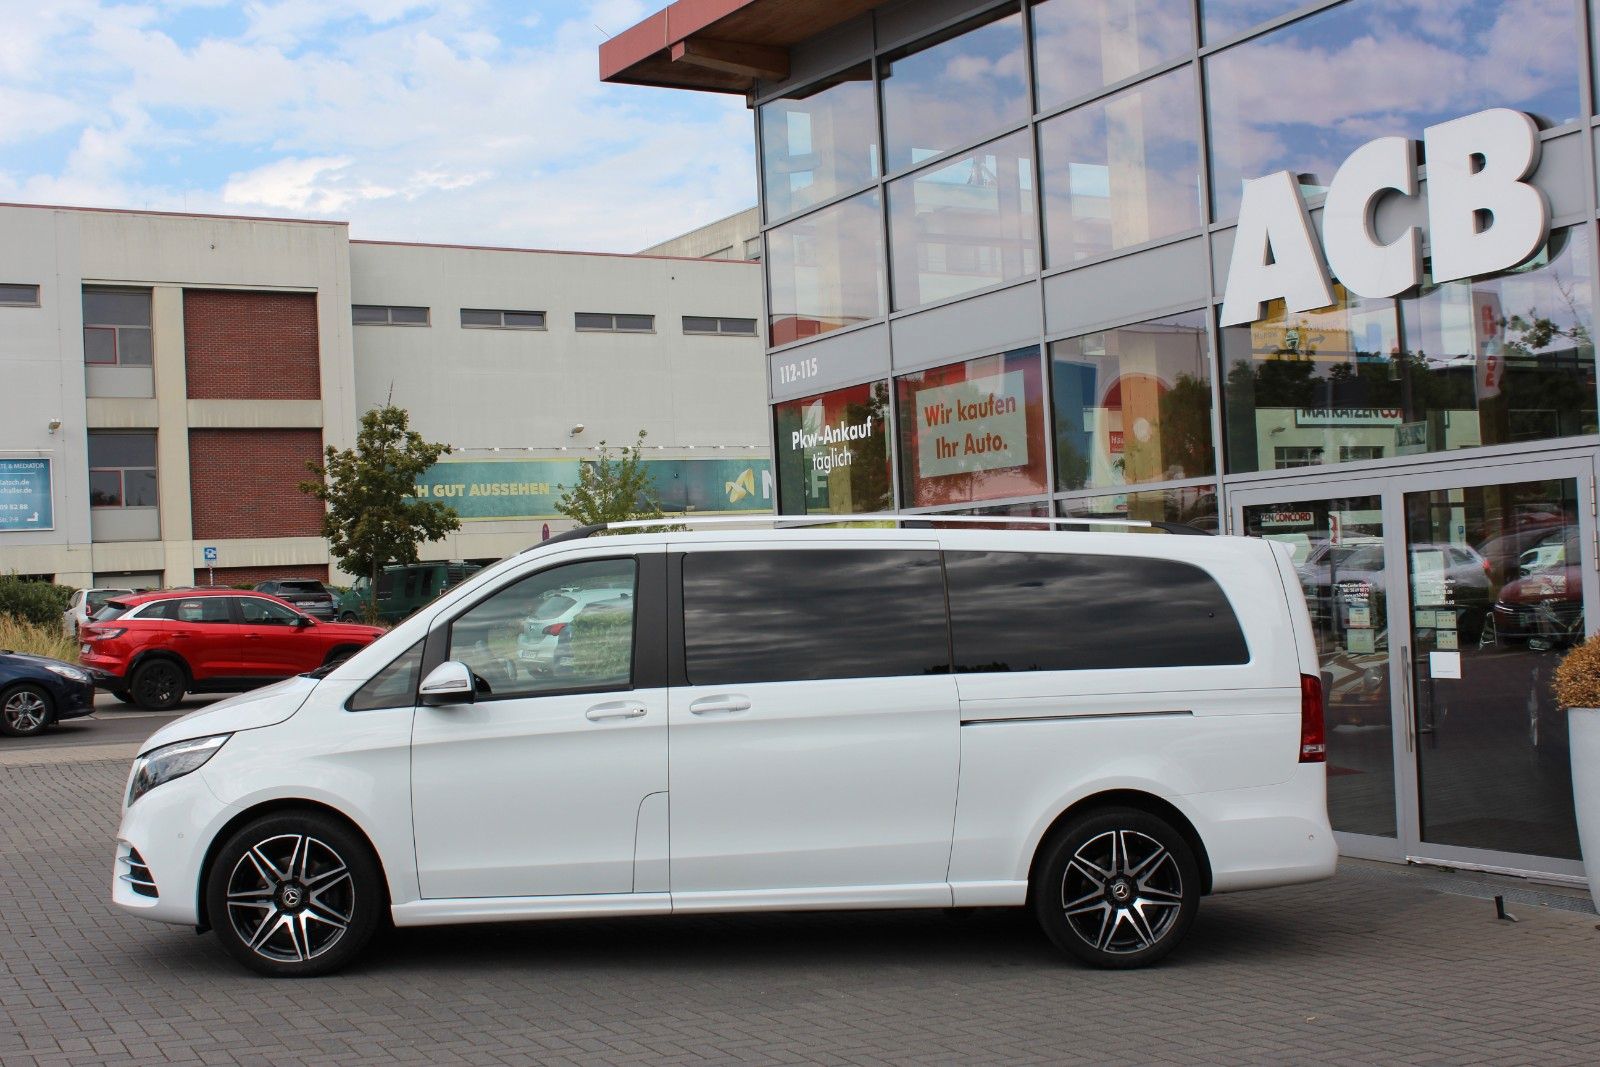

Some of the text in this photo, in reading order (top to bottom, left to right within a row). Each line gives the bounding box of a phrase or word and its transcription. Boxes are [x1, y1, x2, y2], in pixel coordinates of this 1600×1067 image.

[1220, 107, 1549, 328] ACB
[780, 358, 818, 384] 112-115
[924, 393, 1016, 427] Wir kaufen
[792, 416, 872, 450] Pkw-Ankauf
[936, 433, 1008, 459] Ihr Auto.
[813, 446, 852, 474] täglich
[433, 483, 466, 497] GUT
[469, 482, 550, 496] AUSSEHEN
[1275, 510, 1312, 522] CONCORD
